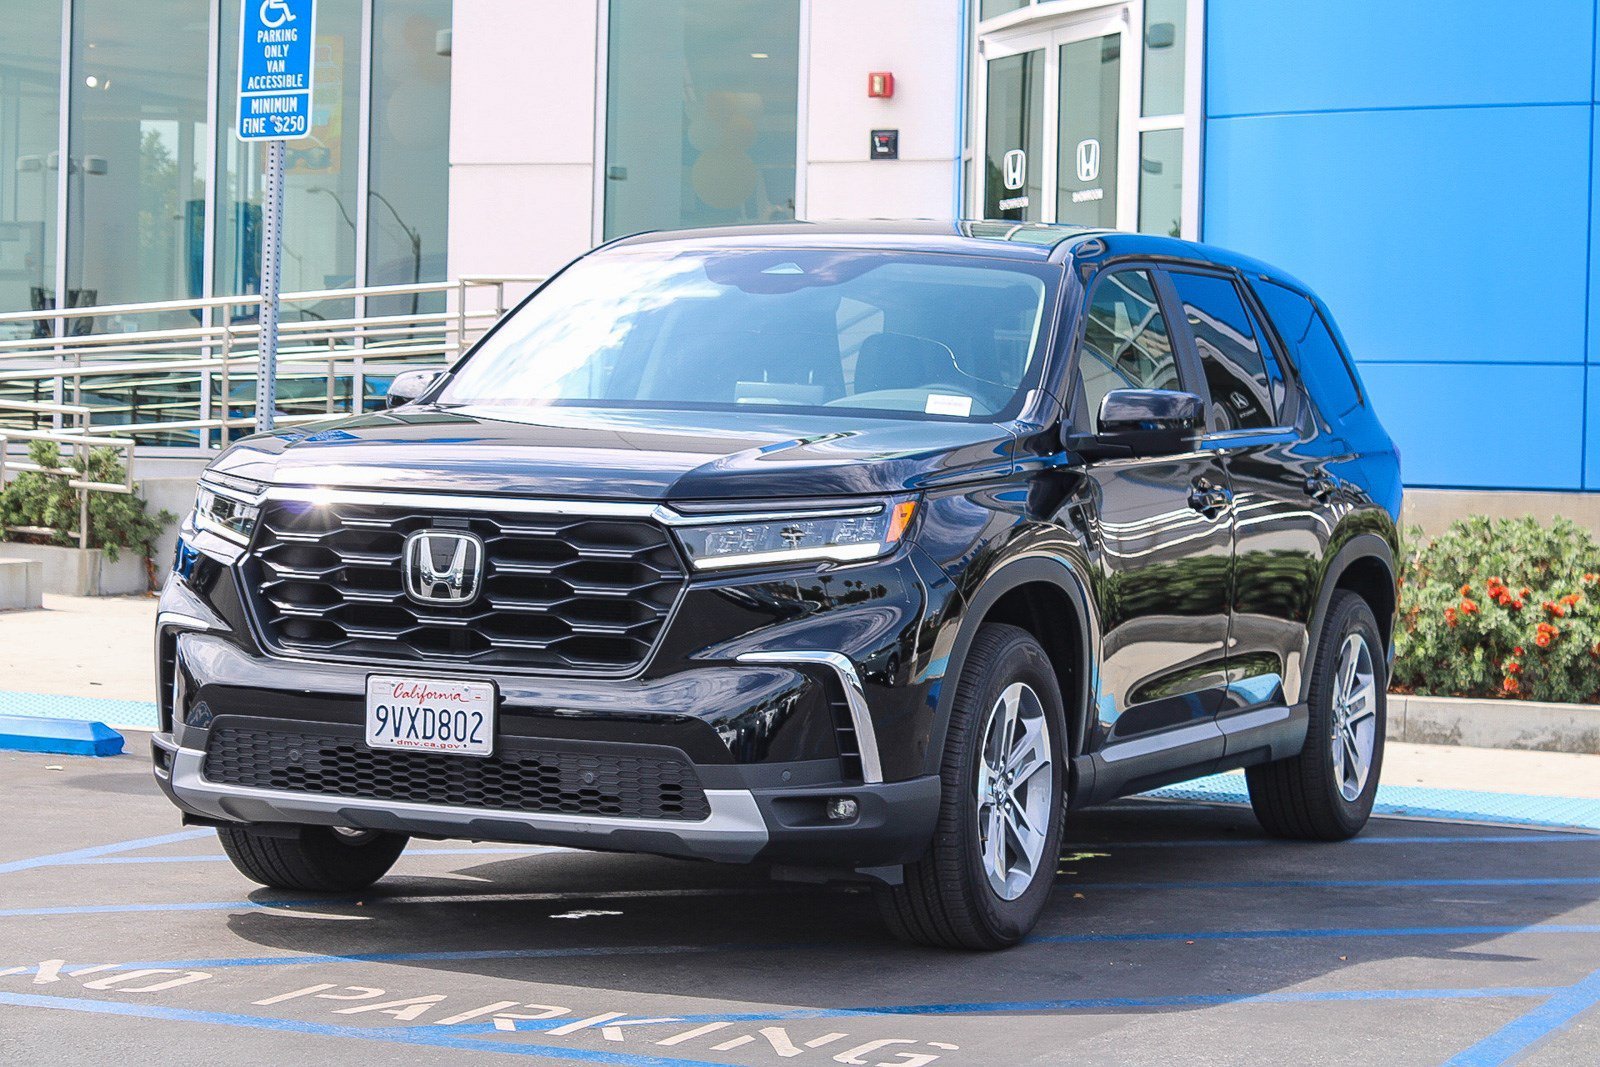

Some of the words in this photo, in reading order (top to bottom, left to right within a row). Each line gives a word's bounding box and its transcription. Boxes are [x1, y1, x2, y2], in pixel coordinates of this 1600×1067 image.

[257, 29, 297, 43] PARKING
[264, 44, 289, 58] ONLY
[266, 60, 285, 73] VAN
[247, 74, 303, 89] ACCESSIBLE
[251, 97, 297, 114] MINIMUM
[243, 118, 266, 133] FINE
[273, 115, 304, 133] $250
[393, 683, 469, 704] California
[374, 704, 484, 744] 9VXD802
[396, 739, 461, 749] dmv.ca.gov
[251, 983, 960, 1067] PARKING
